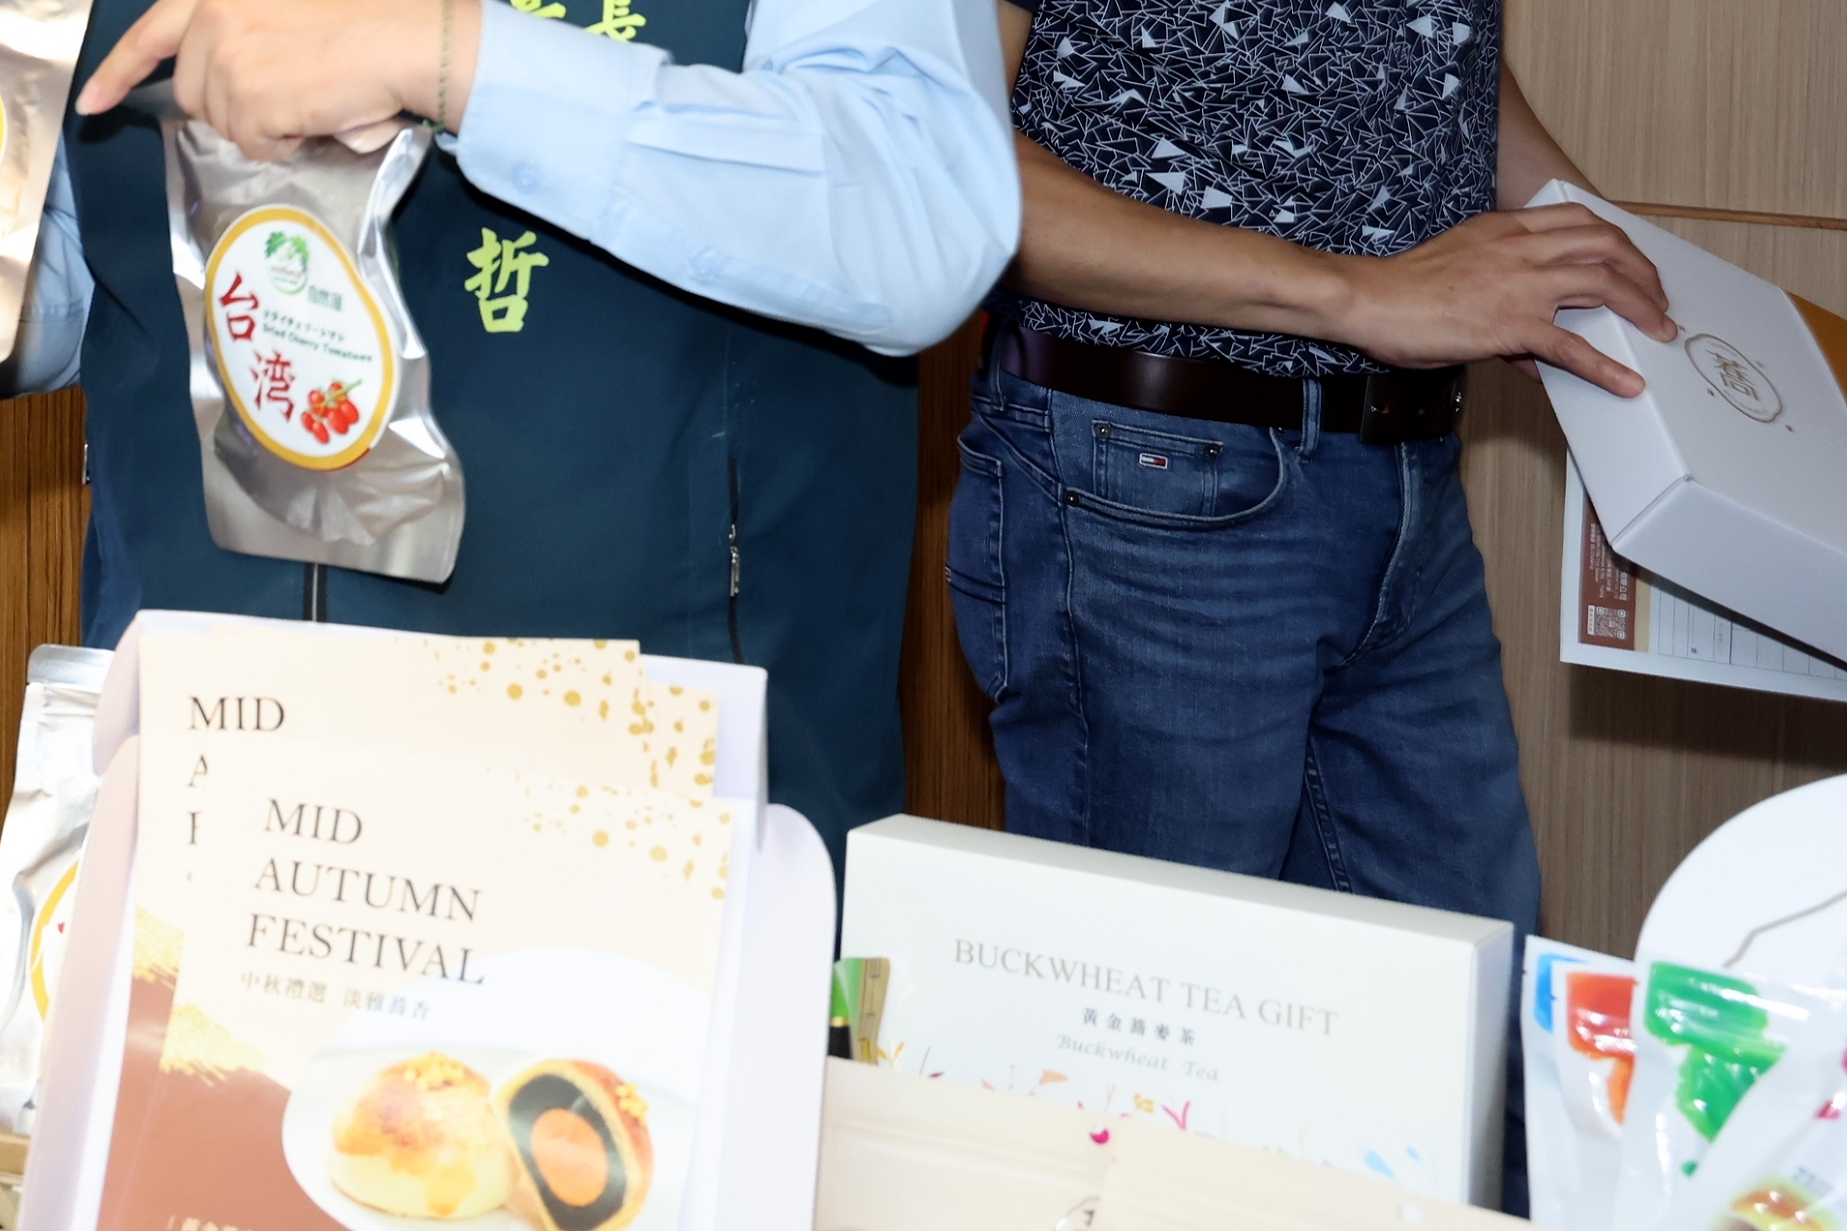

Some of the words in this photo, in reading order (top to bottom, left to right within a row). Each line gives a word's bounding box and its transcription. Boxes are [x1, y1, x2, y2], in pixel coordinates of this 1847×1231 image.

[262, 323, 288, 339] Dried
[288, 330, 320, 351] Cherry
[188, 695, 286, 732] MID
[263, 797, 364, 845] MID
[253, 857, 483, 923] AUTUMN
[245, 912, 485, 986] FESTIVAL
[954, 937, 1171, 1004] BUCKWHEAT
[1180, 981, 1247, 1021] TEA
[1257, 999, 1339, 1037] GIFT
[1057, 1033, 1169, 1073] Buckwheat
[1184, 1059, 1221, 1084] Tea
